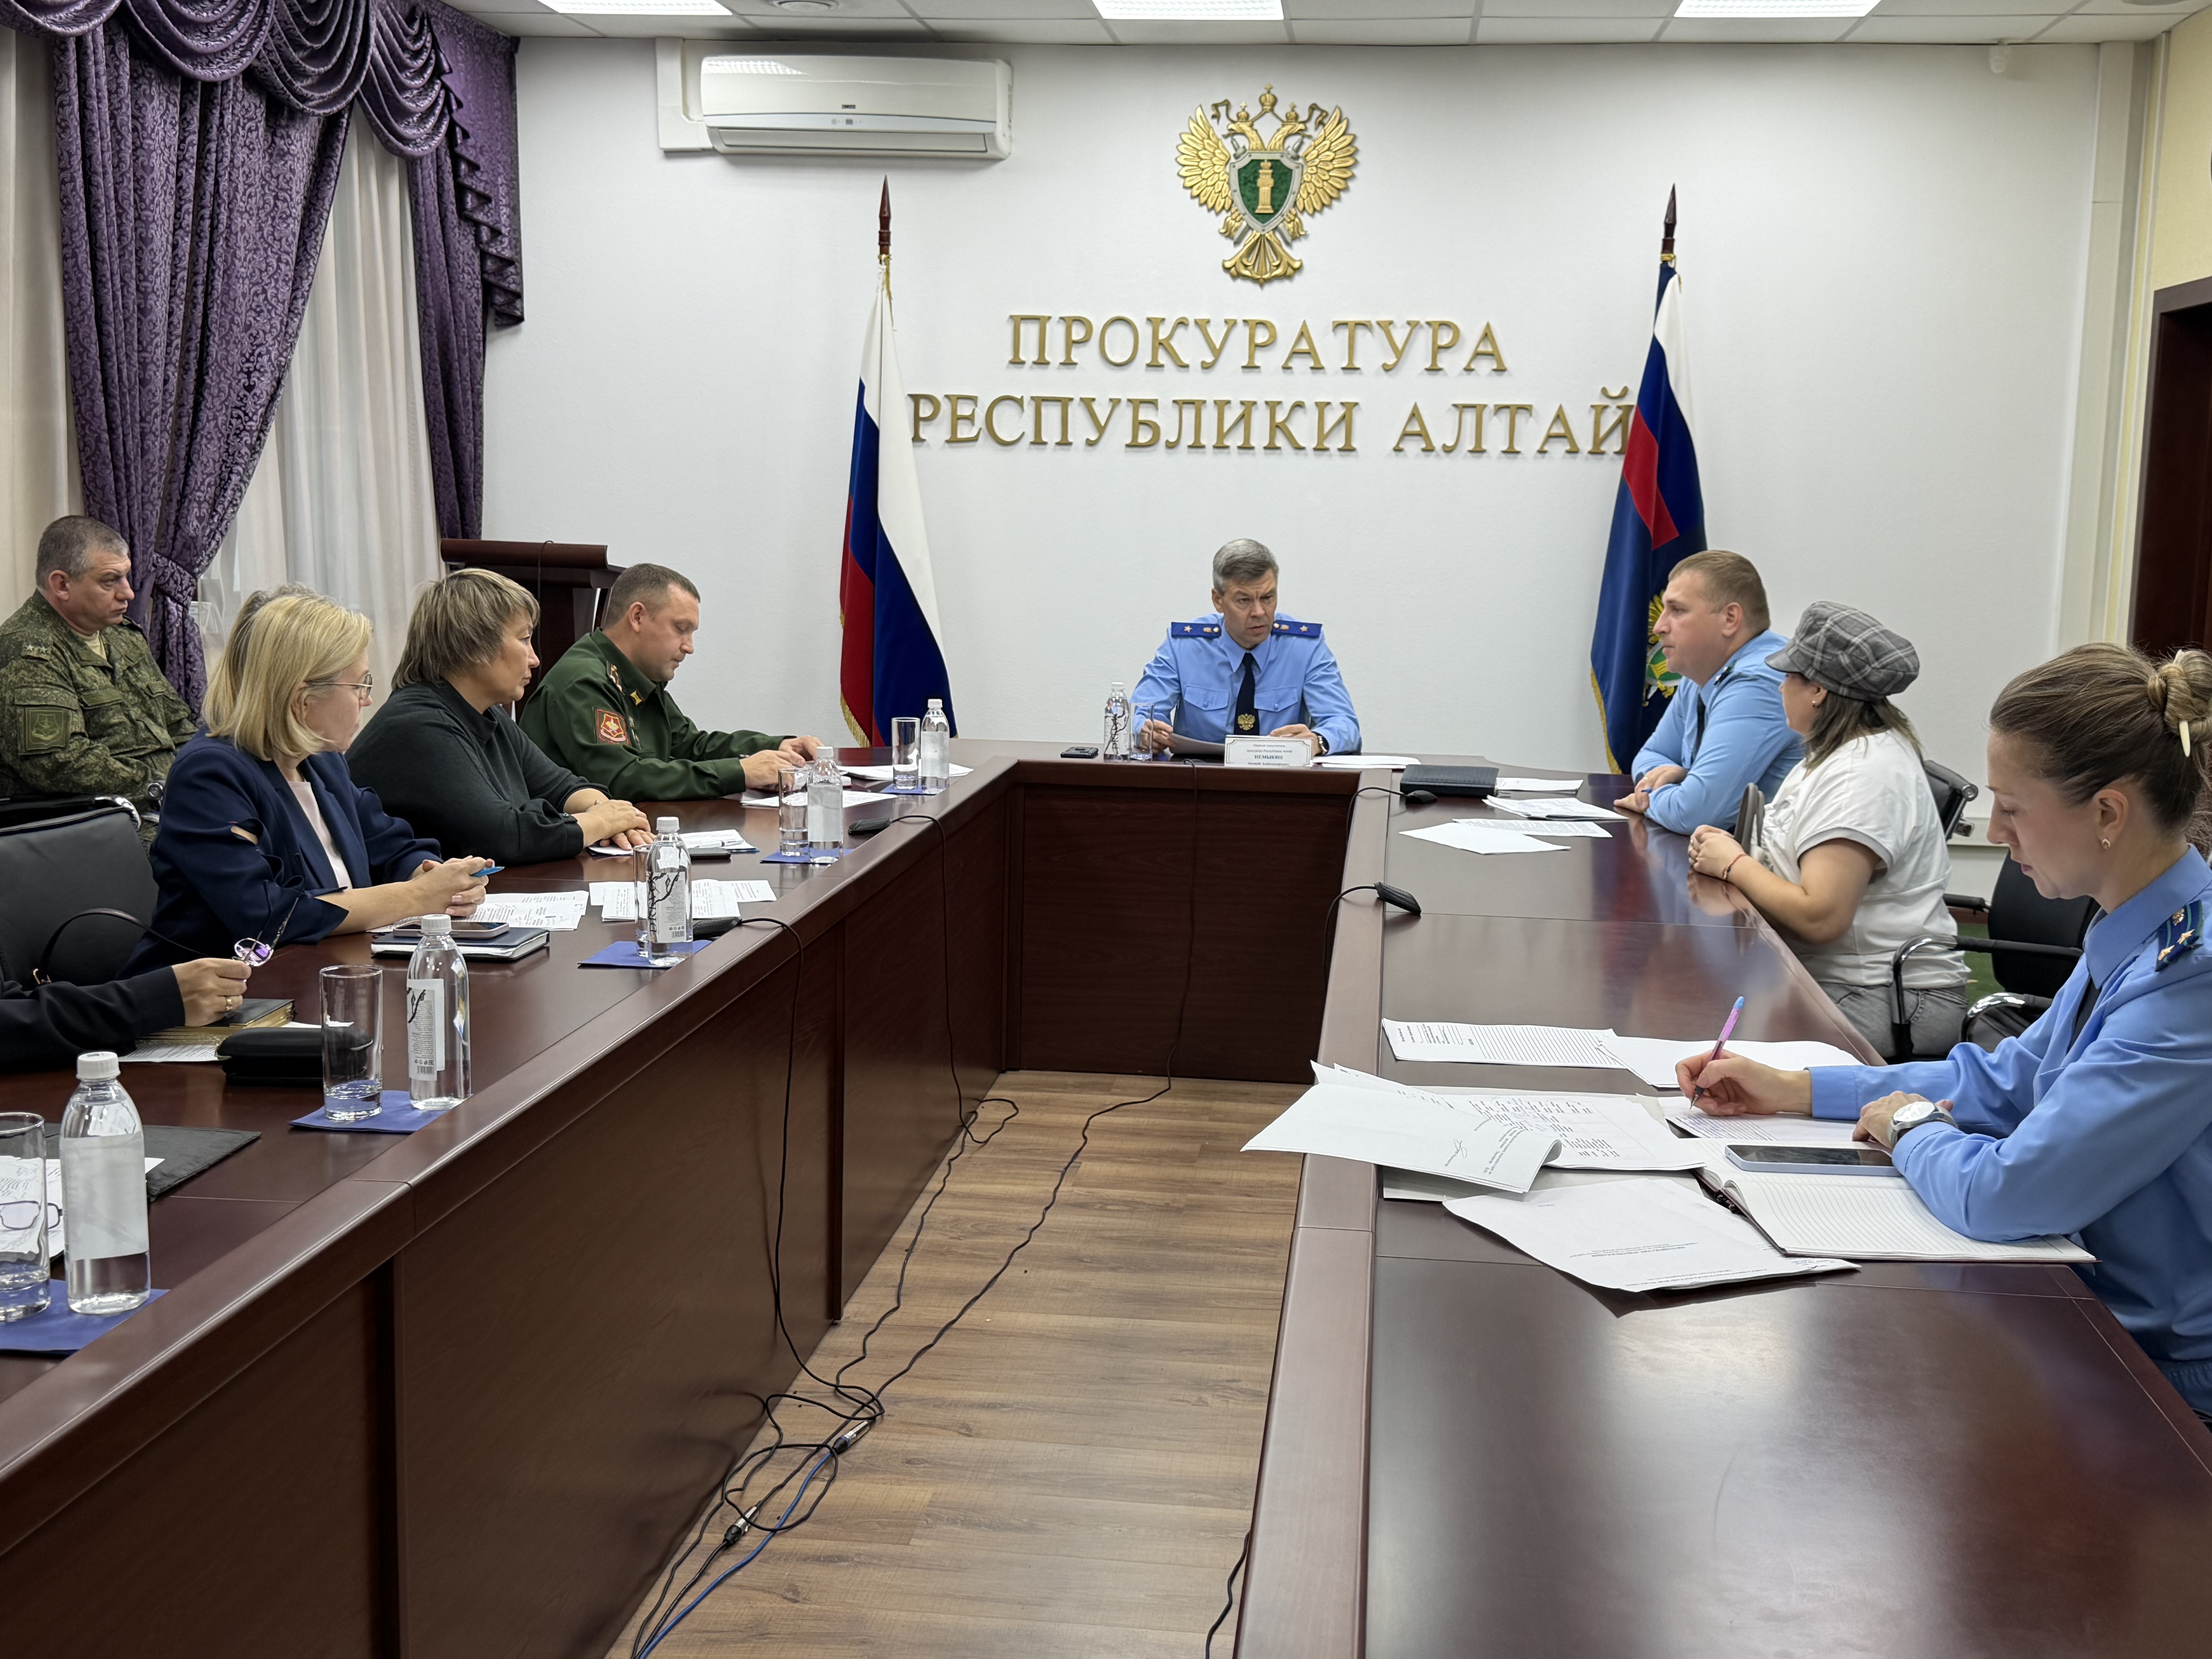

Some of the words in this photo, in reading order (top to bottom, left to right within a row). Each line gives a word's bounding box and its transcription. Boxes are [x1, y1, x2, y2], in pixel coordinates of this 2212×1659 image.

[1008, 314, 1508, 371] ПРОКУРАТУРА
[907, 393, 1359, 450] РЕСПУБЛИКИ
[1393, 385, 1634, 455] АЛТАЙ
